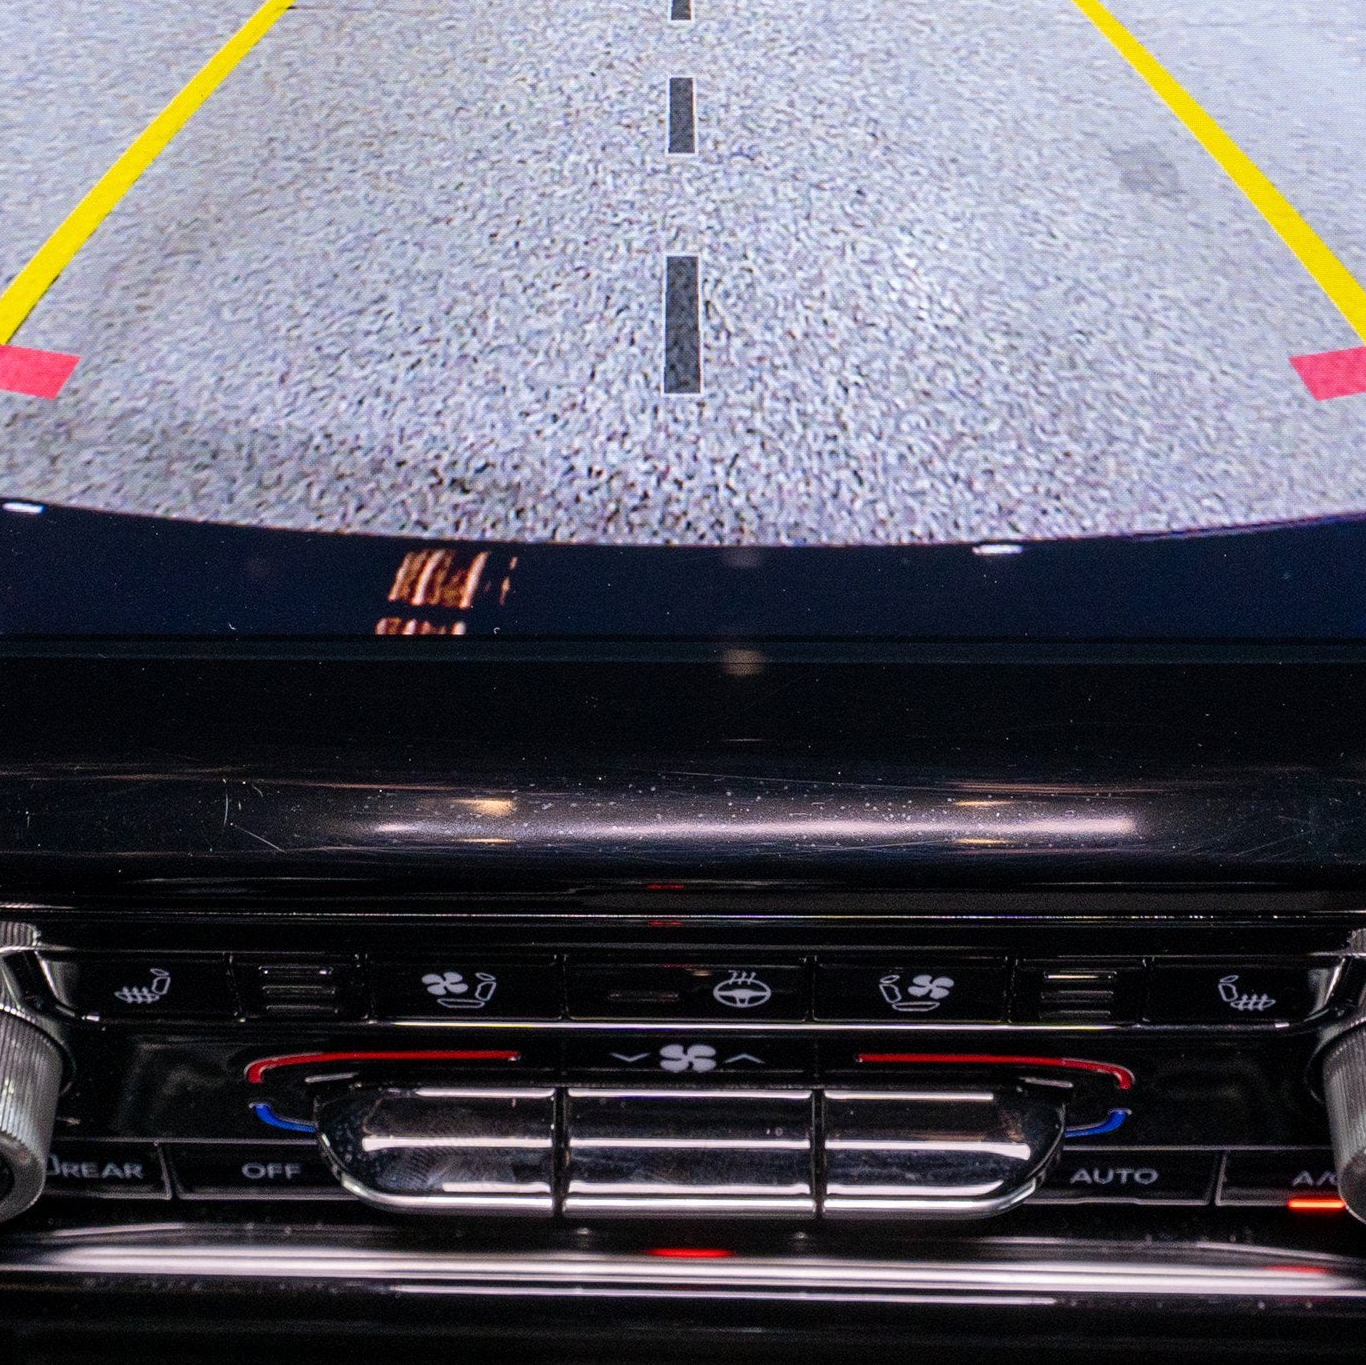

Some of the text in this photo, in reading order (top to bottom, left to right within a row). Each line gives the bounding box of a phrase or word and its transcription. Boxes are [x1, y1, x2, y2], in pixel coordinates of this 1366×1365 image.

[61, 1162, 143, 1178] REAR
[241, 1162, 302, 1179] OFF
[1069, 1168, 1159, 1184] AUTO
